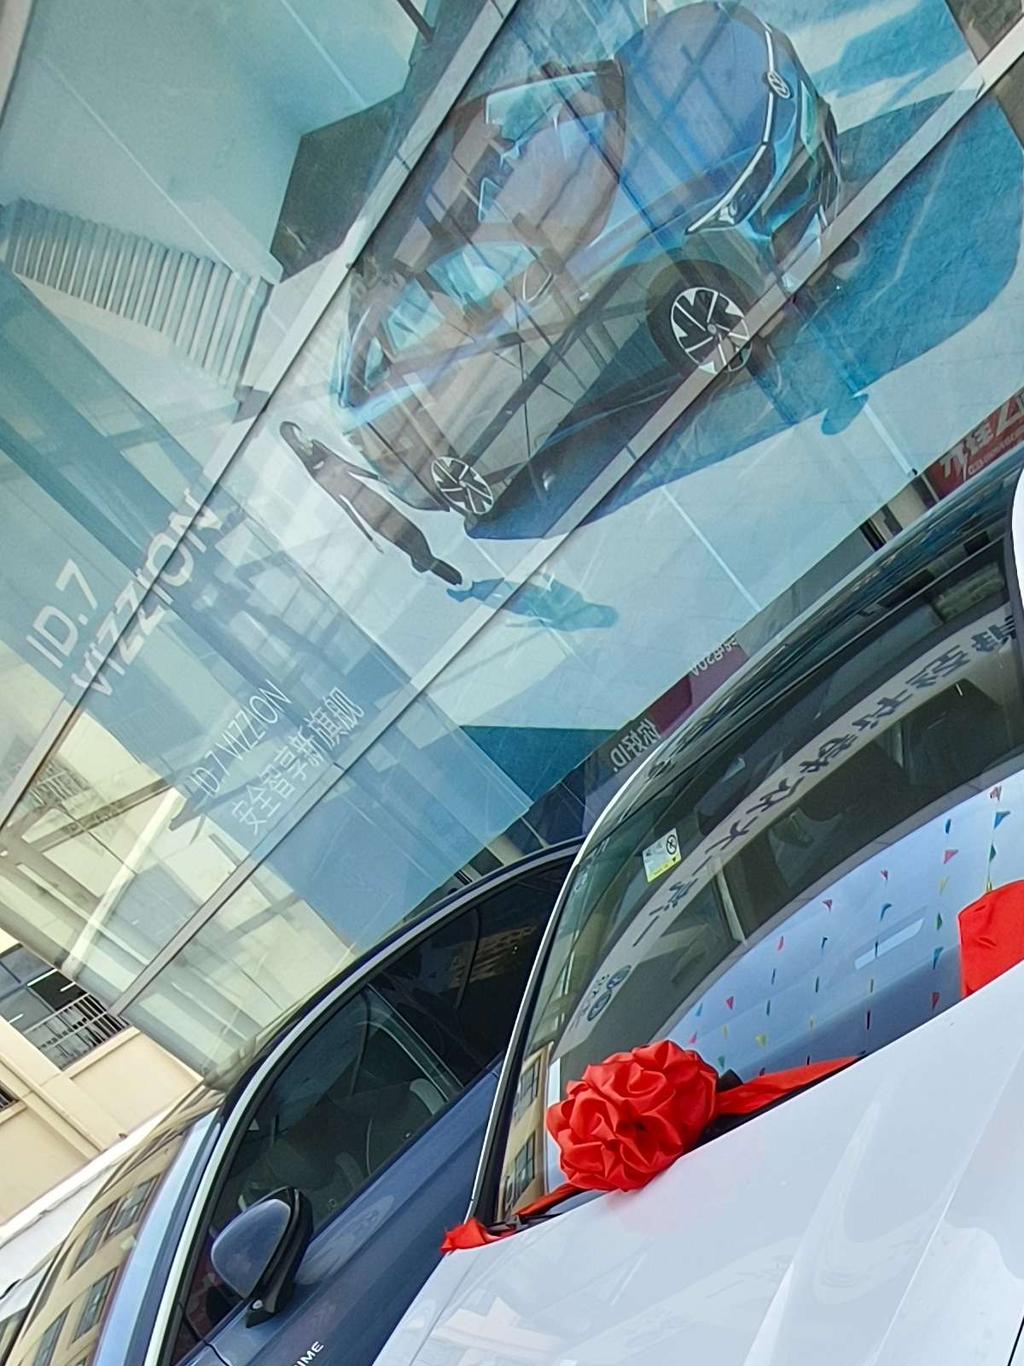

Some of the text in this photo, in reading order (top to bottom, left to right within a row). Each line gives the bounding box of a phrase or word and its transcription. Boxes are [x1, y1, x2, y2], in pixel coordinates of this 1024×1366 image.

[26, 558, 100, 670] ID.7
[72, 488, 228, 699] VIZZION
[215, 678, 293, 761] VIZZION
[231, 686, 365, 836] 安全智享新旗舰
